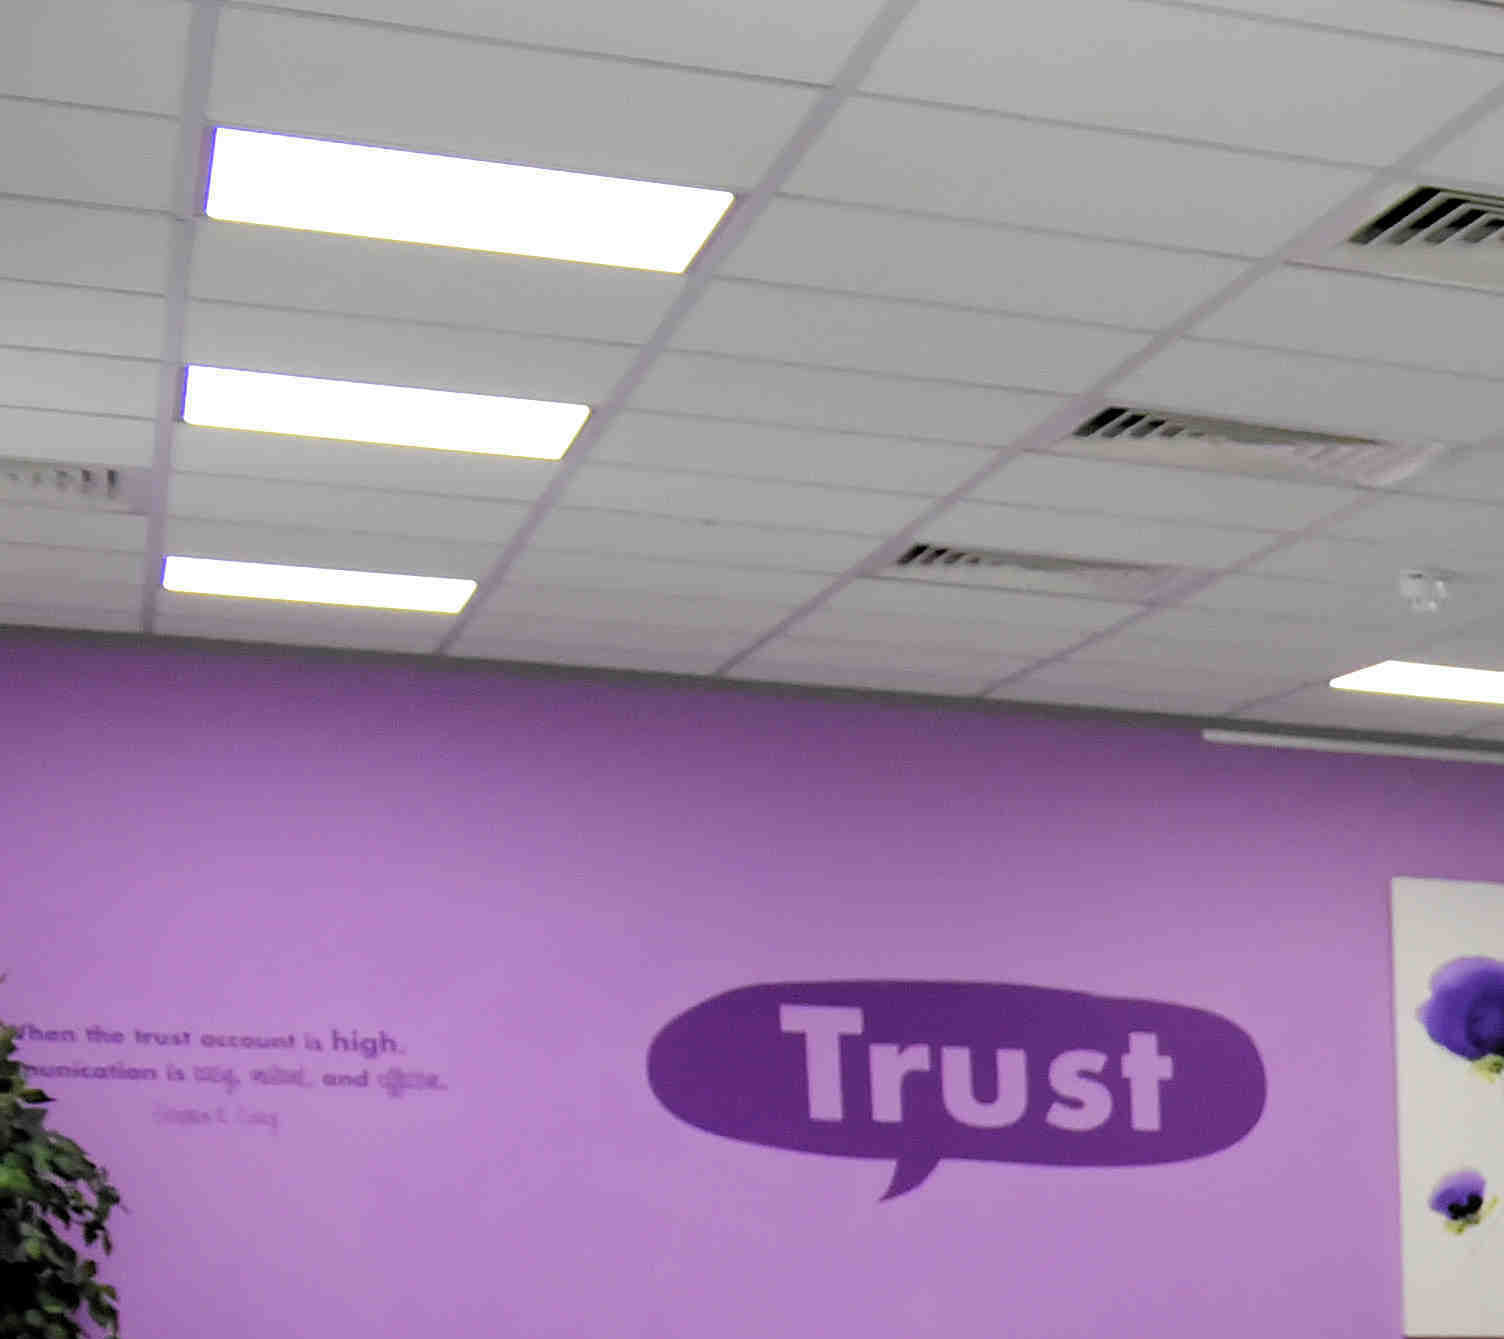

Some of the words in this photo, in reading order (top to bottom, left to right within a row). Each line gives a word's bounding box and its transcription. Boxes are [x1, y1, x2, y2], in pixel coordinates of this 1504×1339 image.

[86, 1025, 125, 1043] the
[133, 1027, 192, 1046] trust
[200, 1031, 296, 1048] account
[166, 1061, 185, 1081] is
[321, 1068, 369, 1088] and
[779, 1002, 1174, 1132] Trust
